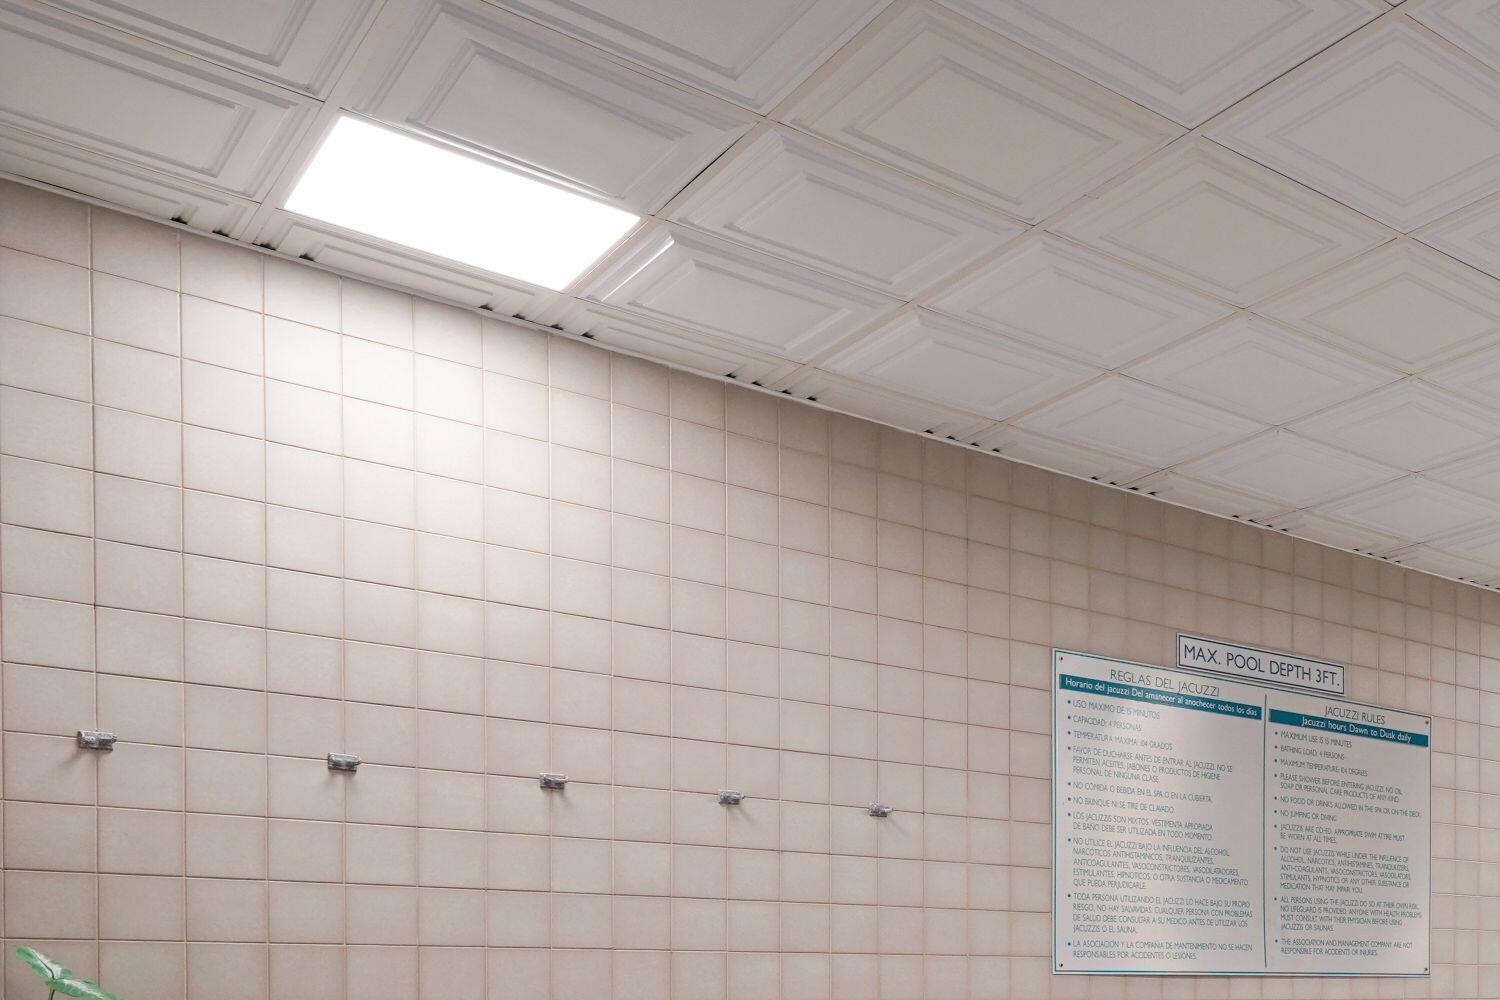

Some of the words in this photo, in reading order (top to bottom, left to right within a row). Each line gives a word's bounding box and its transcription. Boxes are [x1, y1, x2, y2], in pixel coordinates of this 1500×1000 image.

[1184, 644, 1221, 665] MAX.
[1226, 652, 1265, 673] POOL
[1269, 660, 1311, 681] DEPTH
[1315, 668, 1340, 687] 3FT.
[1065, 676, 1092, 689] Horario
[1094, 681, 1104, 691] del
[1106, 684, 1129, 697] jacuzzi
[1131, 687, 1143, 698] Del
[1144, 691, 1174, 703] amanecer
[1177, 695, 1183, 704] al
[1184, 696, 1215, 709] anochecer
[1217, 702, 1234, 712] todos
[1236, 705, 1244, 714] los
[1110, 668, 1151, 686] REGLAS
[1155, 676, 1173, 690] DEL
[1178, 680, 1220, 700] JACUZZI
[1301, 716, 1325, 729] Jacuzzi
[1328, 720, 1346, 731] hours
[1349, 724, 1368, 735] Dawn
[1370, 727, 1377, 736] to
[1379, 729, 1395, 739] Dusk
[1397, 732, 1411, 743] daily
[1325, 705, 1358, 722] JACUZZI
[1361, 712, 1385, 725] RULES
